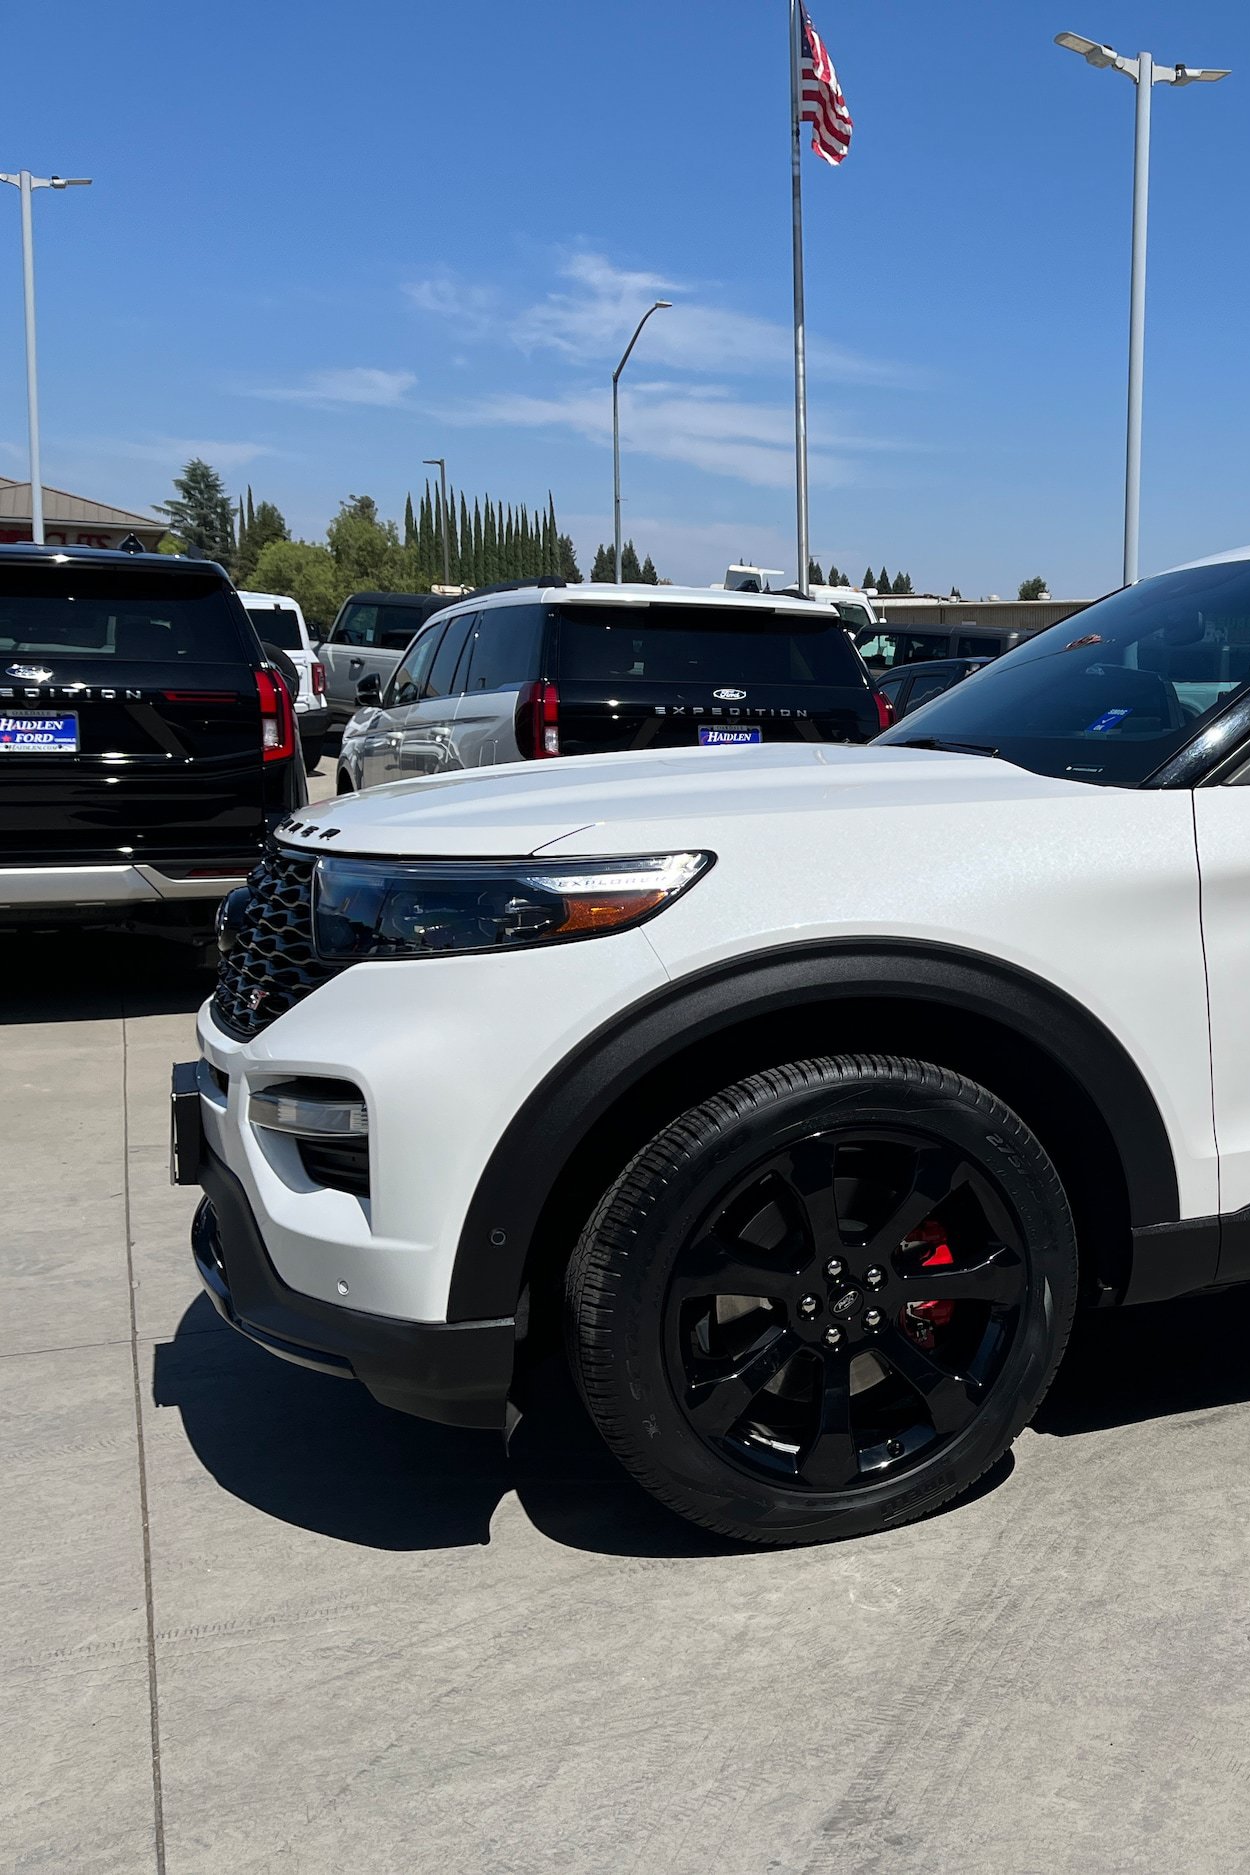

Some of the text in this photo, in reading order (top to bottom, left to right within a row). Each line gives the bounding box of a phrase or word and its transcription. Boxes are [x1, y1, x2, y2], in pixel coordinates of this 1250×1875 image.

[654, 706, 808, 718] EXPEDITION
[0, 718, 64, 731] HAIDLEN
[15, 733, 54, 743] FORD
[707, 731, 752, 743] HAIDLEN
